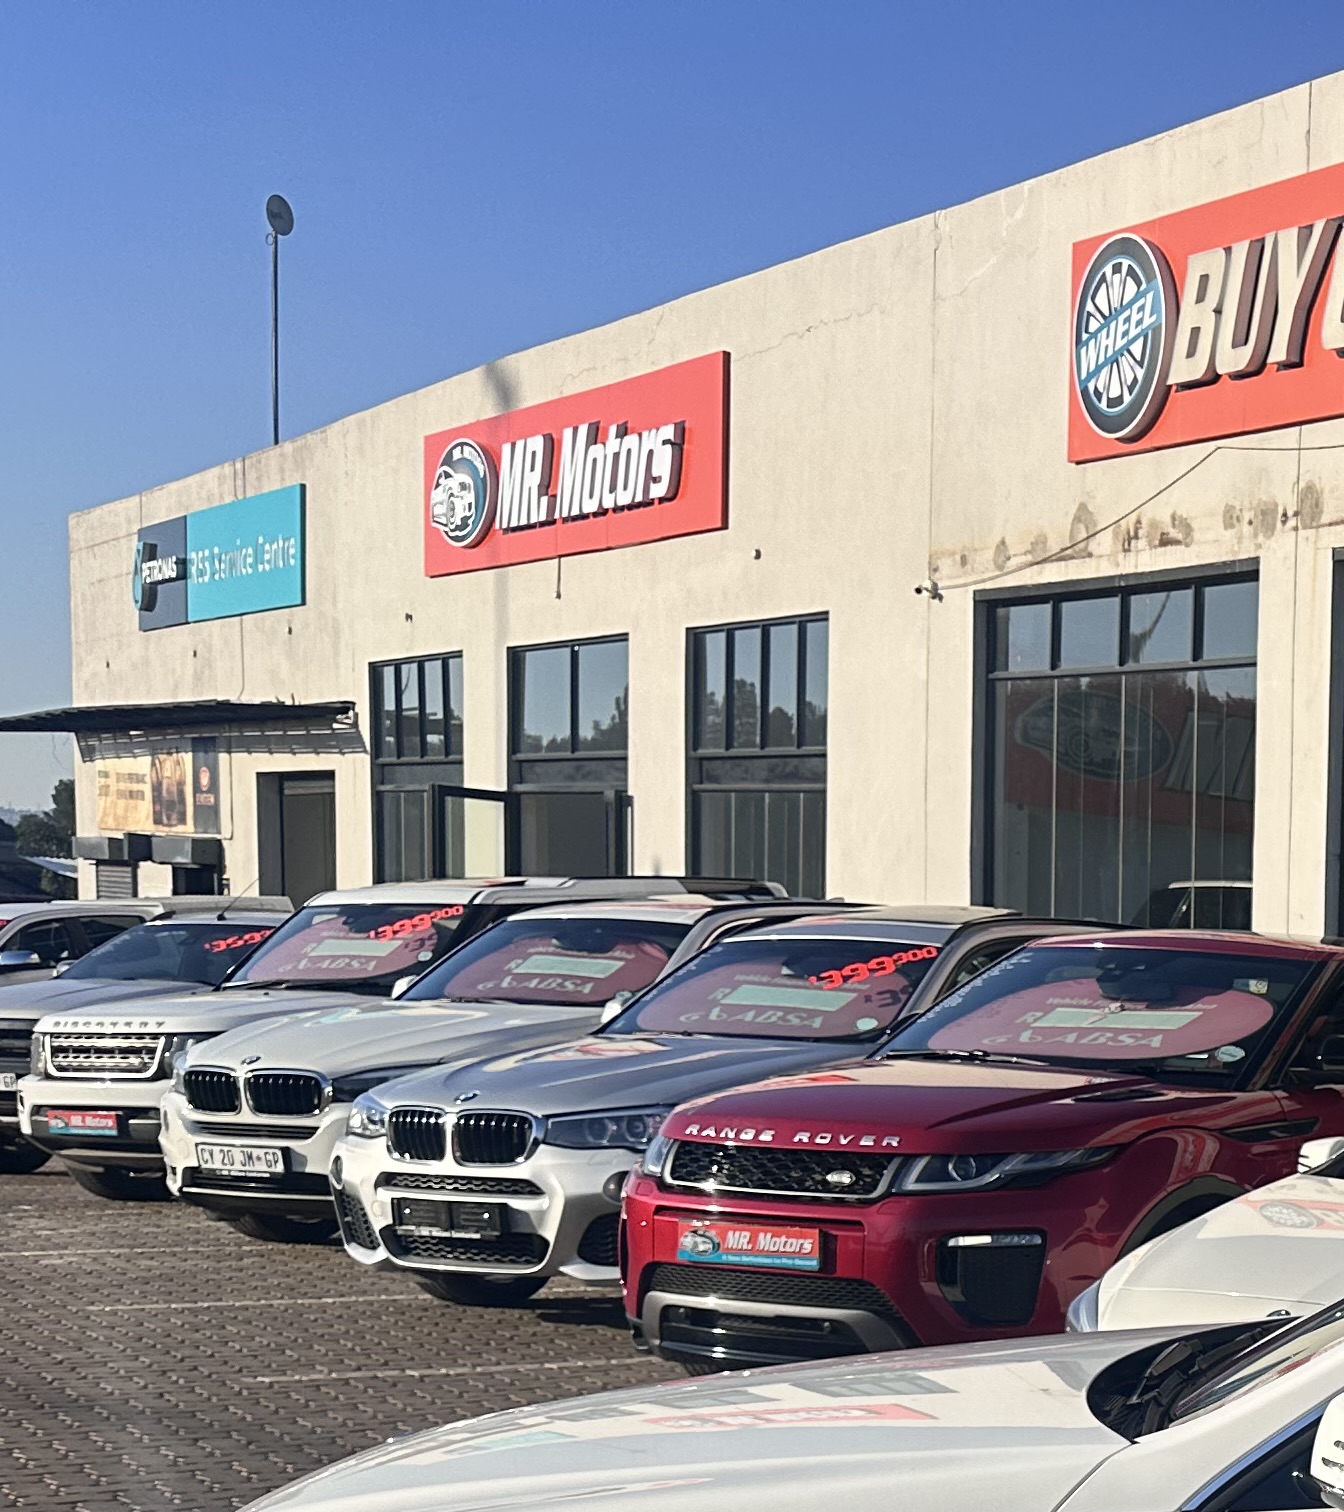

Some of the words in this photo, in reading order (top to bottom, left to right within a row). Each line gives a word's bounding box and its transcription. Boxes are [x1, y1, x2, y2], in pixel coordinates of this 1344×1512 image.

[1080, 290, 1158, 381] WHEEL
[494, 434, 556, 530] MR.
[554, 422, 675, 519] Motors
[213, 538, 253, 581] Service
[257, 535, 296, 572] Centre
[142, 556, 177, 584] PETRONAS
[519, 976, 596, 994] ABSA
[733, 1007, 825, 1029] ABSA
[1054, 1030, 1163, 1048] ABSA
[685, 1124, 776, 1142] RANGE
[792, 1131, 900, 1147] ROVER
[264, 1152, 279, 1169] GP
[726, 1231, 752, 1250] MR.
[757, 1232, 813, 1254] Motors
